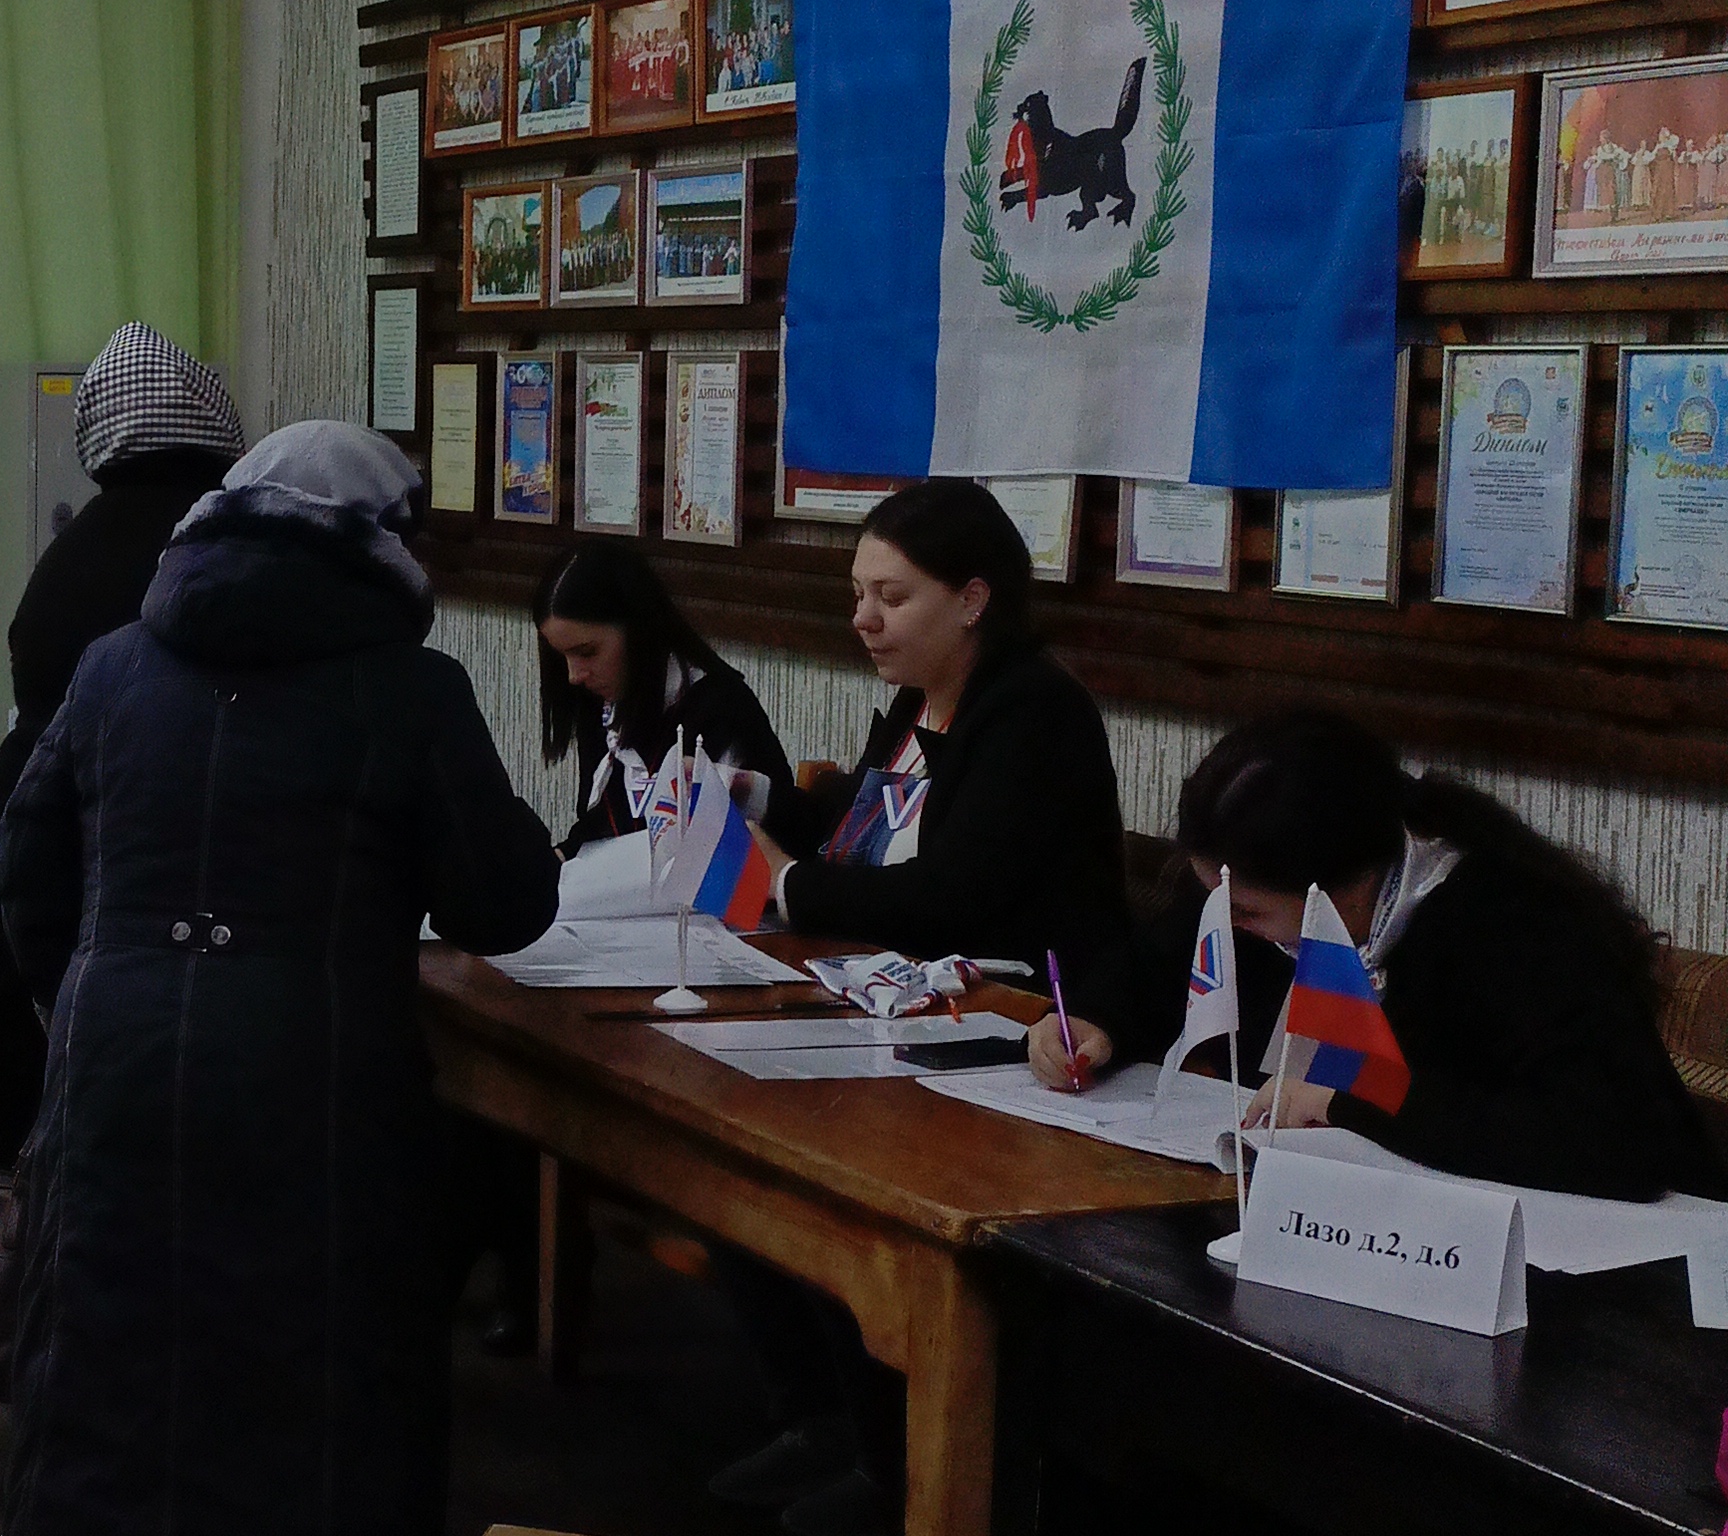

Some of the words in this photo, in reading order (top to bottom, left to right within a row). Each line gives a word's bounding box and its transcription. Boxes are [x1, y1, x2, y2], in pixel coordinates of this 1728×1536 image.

[1279, 1210, 1350, 1246] Лазо
[1358, 1232, 1408, 1263] д.2,
[1416, 1245, 1461, 1269] д.6
